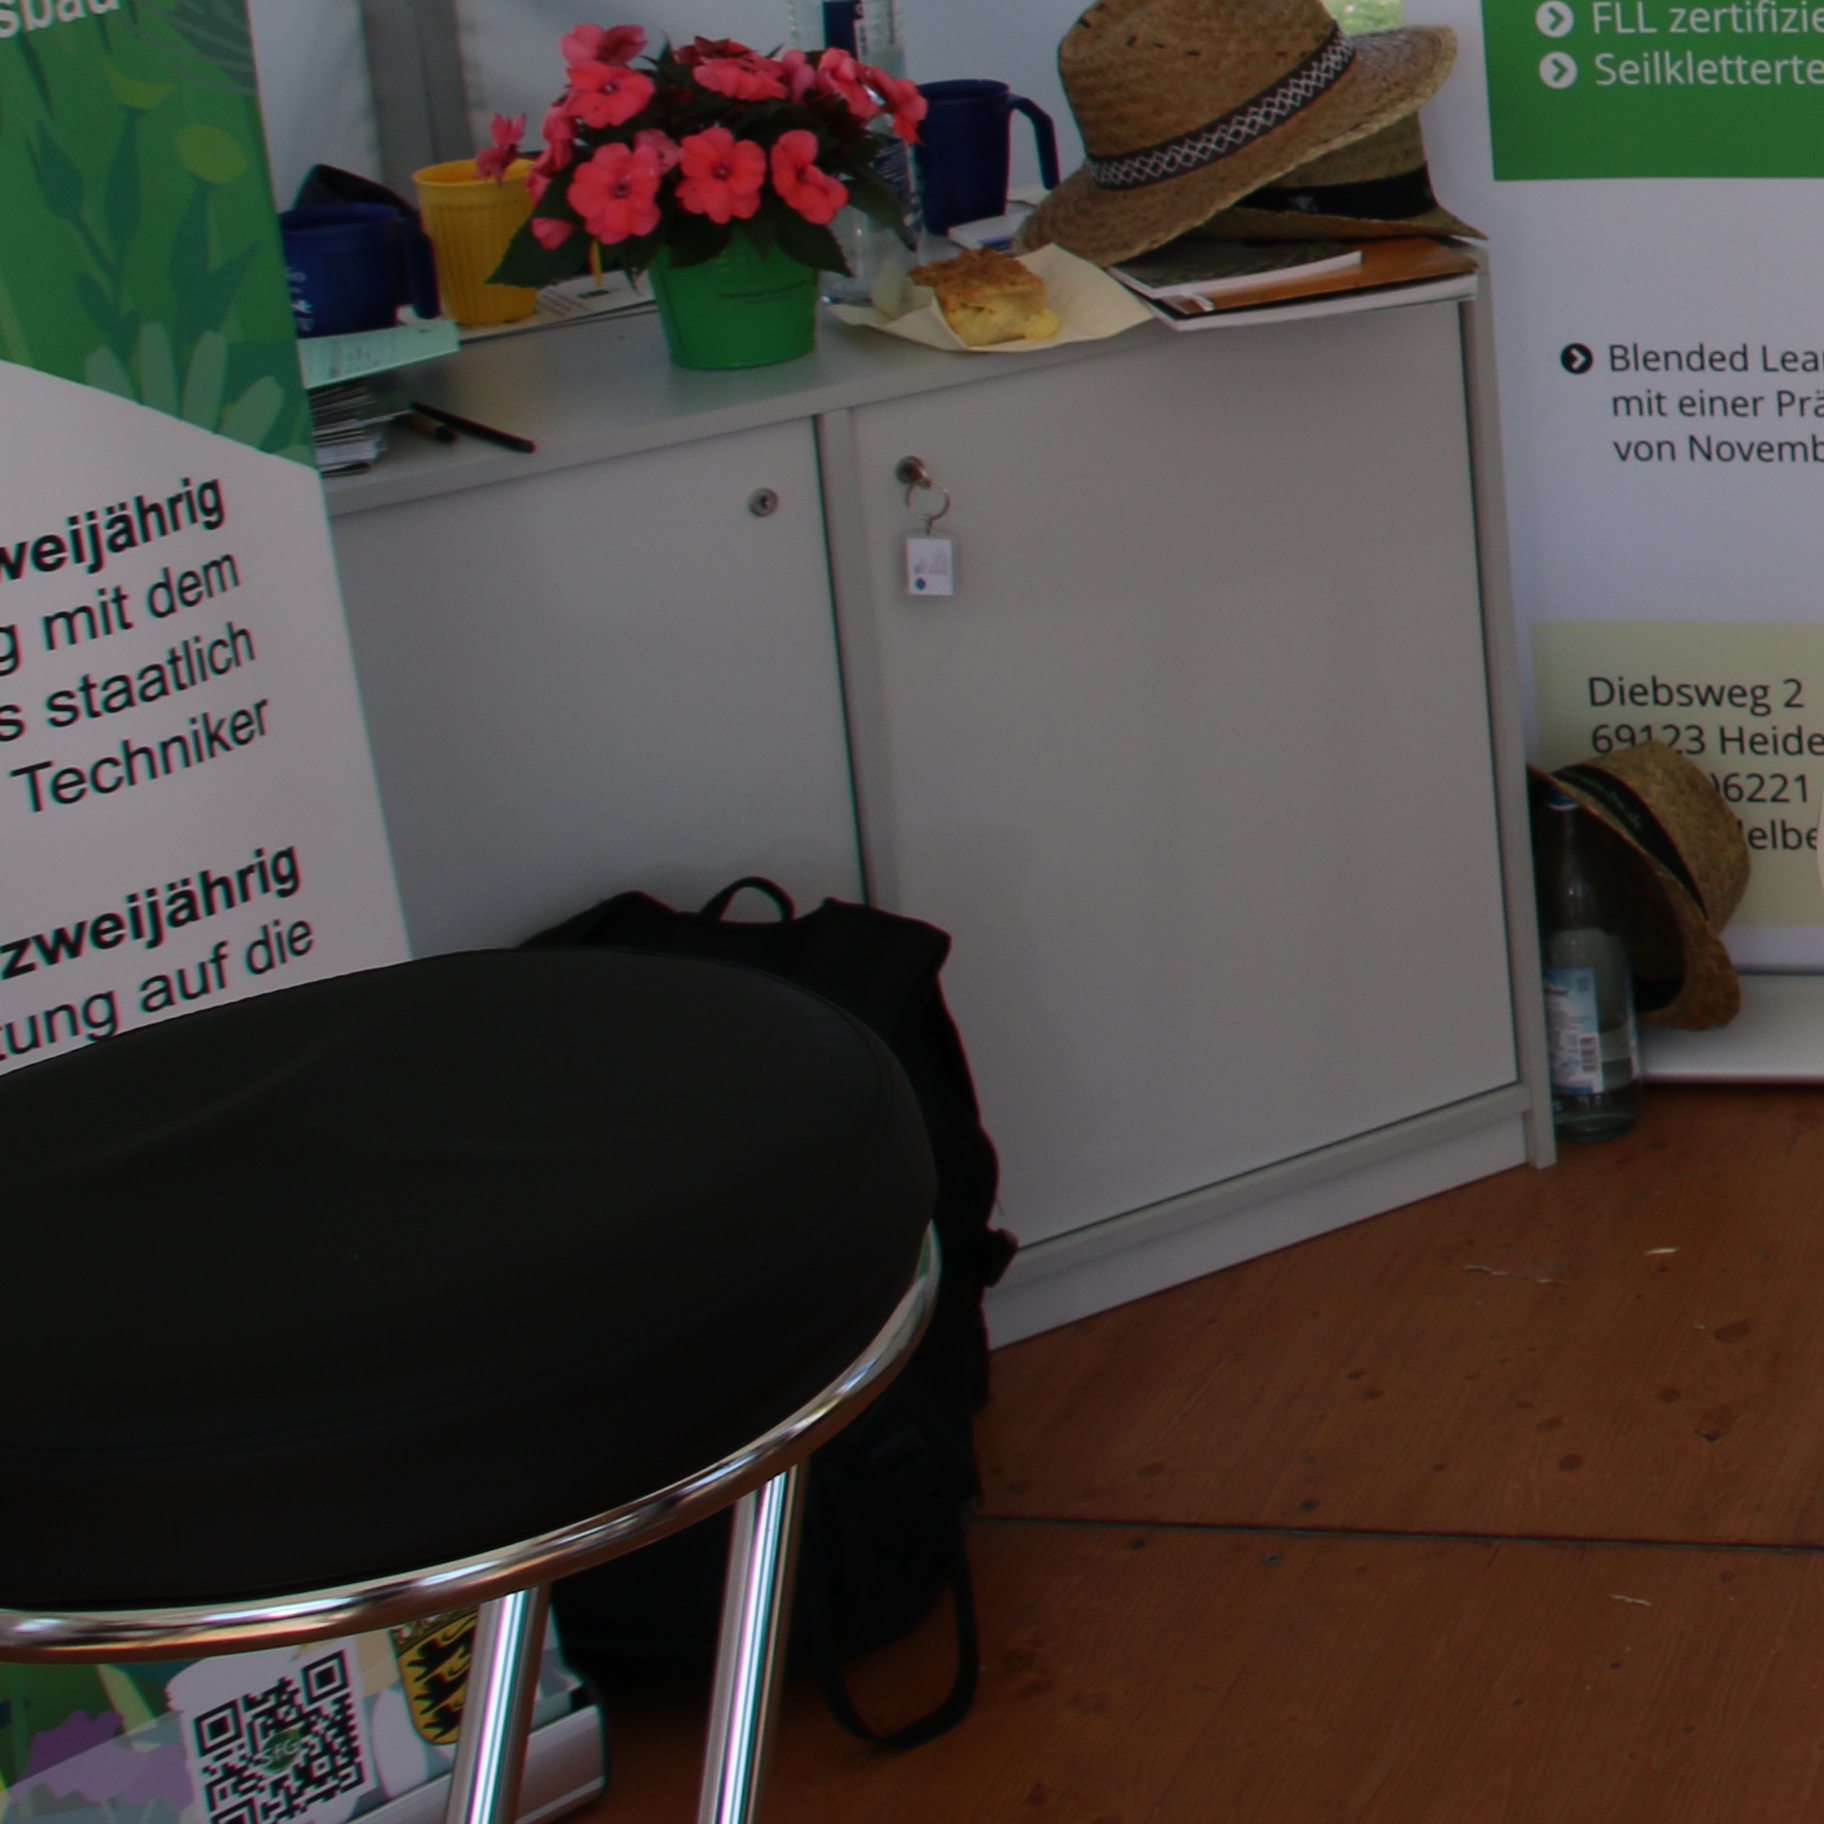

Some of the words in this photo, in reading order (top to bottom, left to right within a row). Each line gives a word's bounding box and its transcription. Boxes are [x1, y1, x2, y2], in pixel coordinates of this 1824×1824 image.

[1593, 1, 1657, 34] FLL
[1609, 343, 1748, 372] Blended
[1612, 389, 1667, 417] mit
[1678, 389, 1764, 417] einer
[1613, 441, 1676, 462] von
[42, 585, 135, 651] mit
[147, 553, 243, 619] dem
[45, 621, 259, 729] staatlich
[1589, 676, 1771, 717] Diebsweg
[1784, 678, 1804, 708] 2
[10, 698, 271, 813] Techniker
[0, 845, 303, 980] zweijährig
[0, 990, 120, 1061] ung
[139, 940, 230, 1014] auf
[245, 919, 314, 976] die
